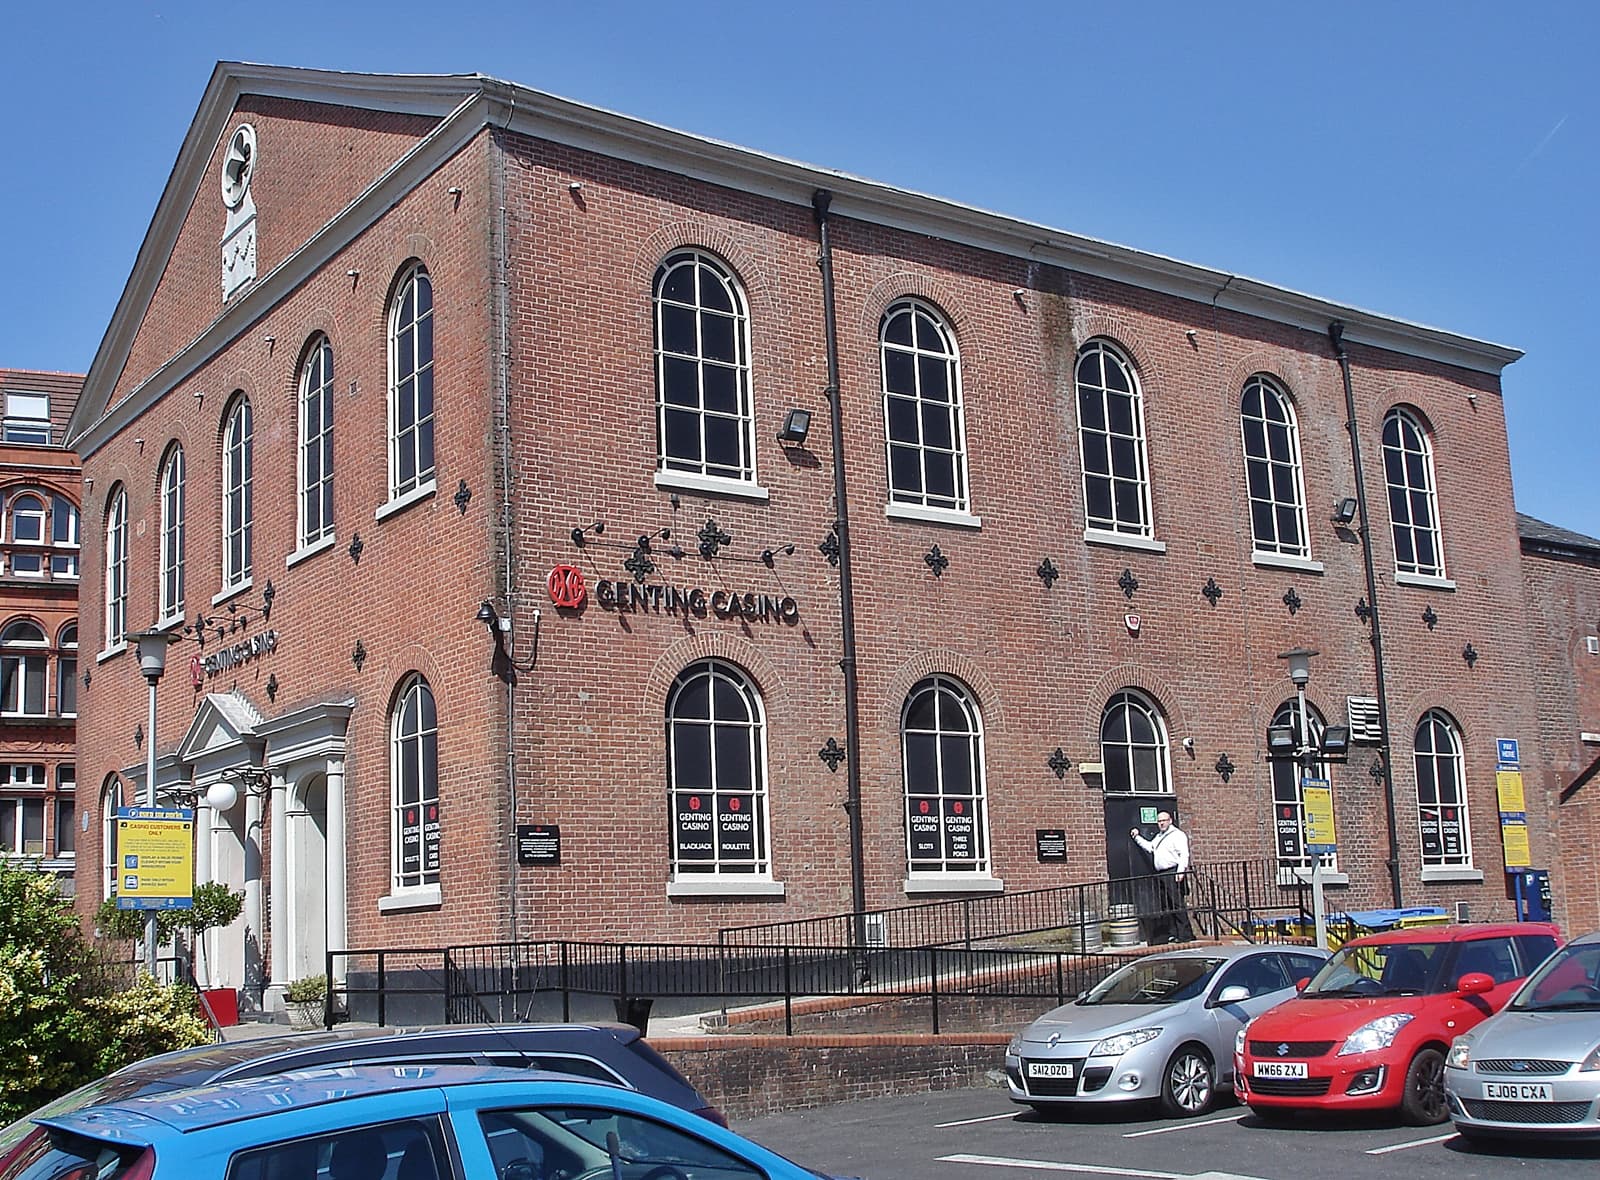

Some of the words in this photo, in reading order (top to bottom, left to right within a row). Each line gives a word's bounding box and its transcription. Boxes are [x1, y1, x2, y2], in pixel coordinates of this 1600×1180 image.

[596, 580, 706, 613] GENTING
[710, 590, 799, 618] CASINO
[680, 813, 711, 821] GENTING
[720, 814, 751, 822] GENTING
[911, 815, 938, 823] GENTING
[945, 816, 972, 824] GENTING
[425, 823, 440, 832] GENTIN
[682, 822, 709, 830] CASINO
[722, 823, 749, 831] CASINO
[913, 824, 937, 832] CASINO
[404, 835, 418, 843] CASINO
[1032, 1065, 1049, 1076] SA12
[1284, 1065, 1304, 1076] ZXJ
[1487, 1085, 1518, 1098] EJ08
[1521, 1086, 1547, 1099] CXA
